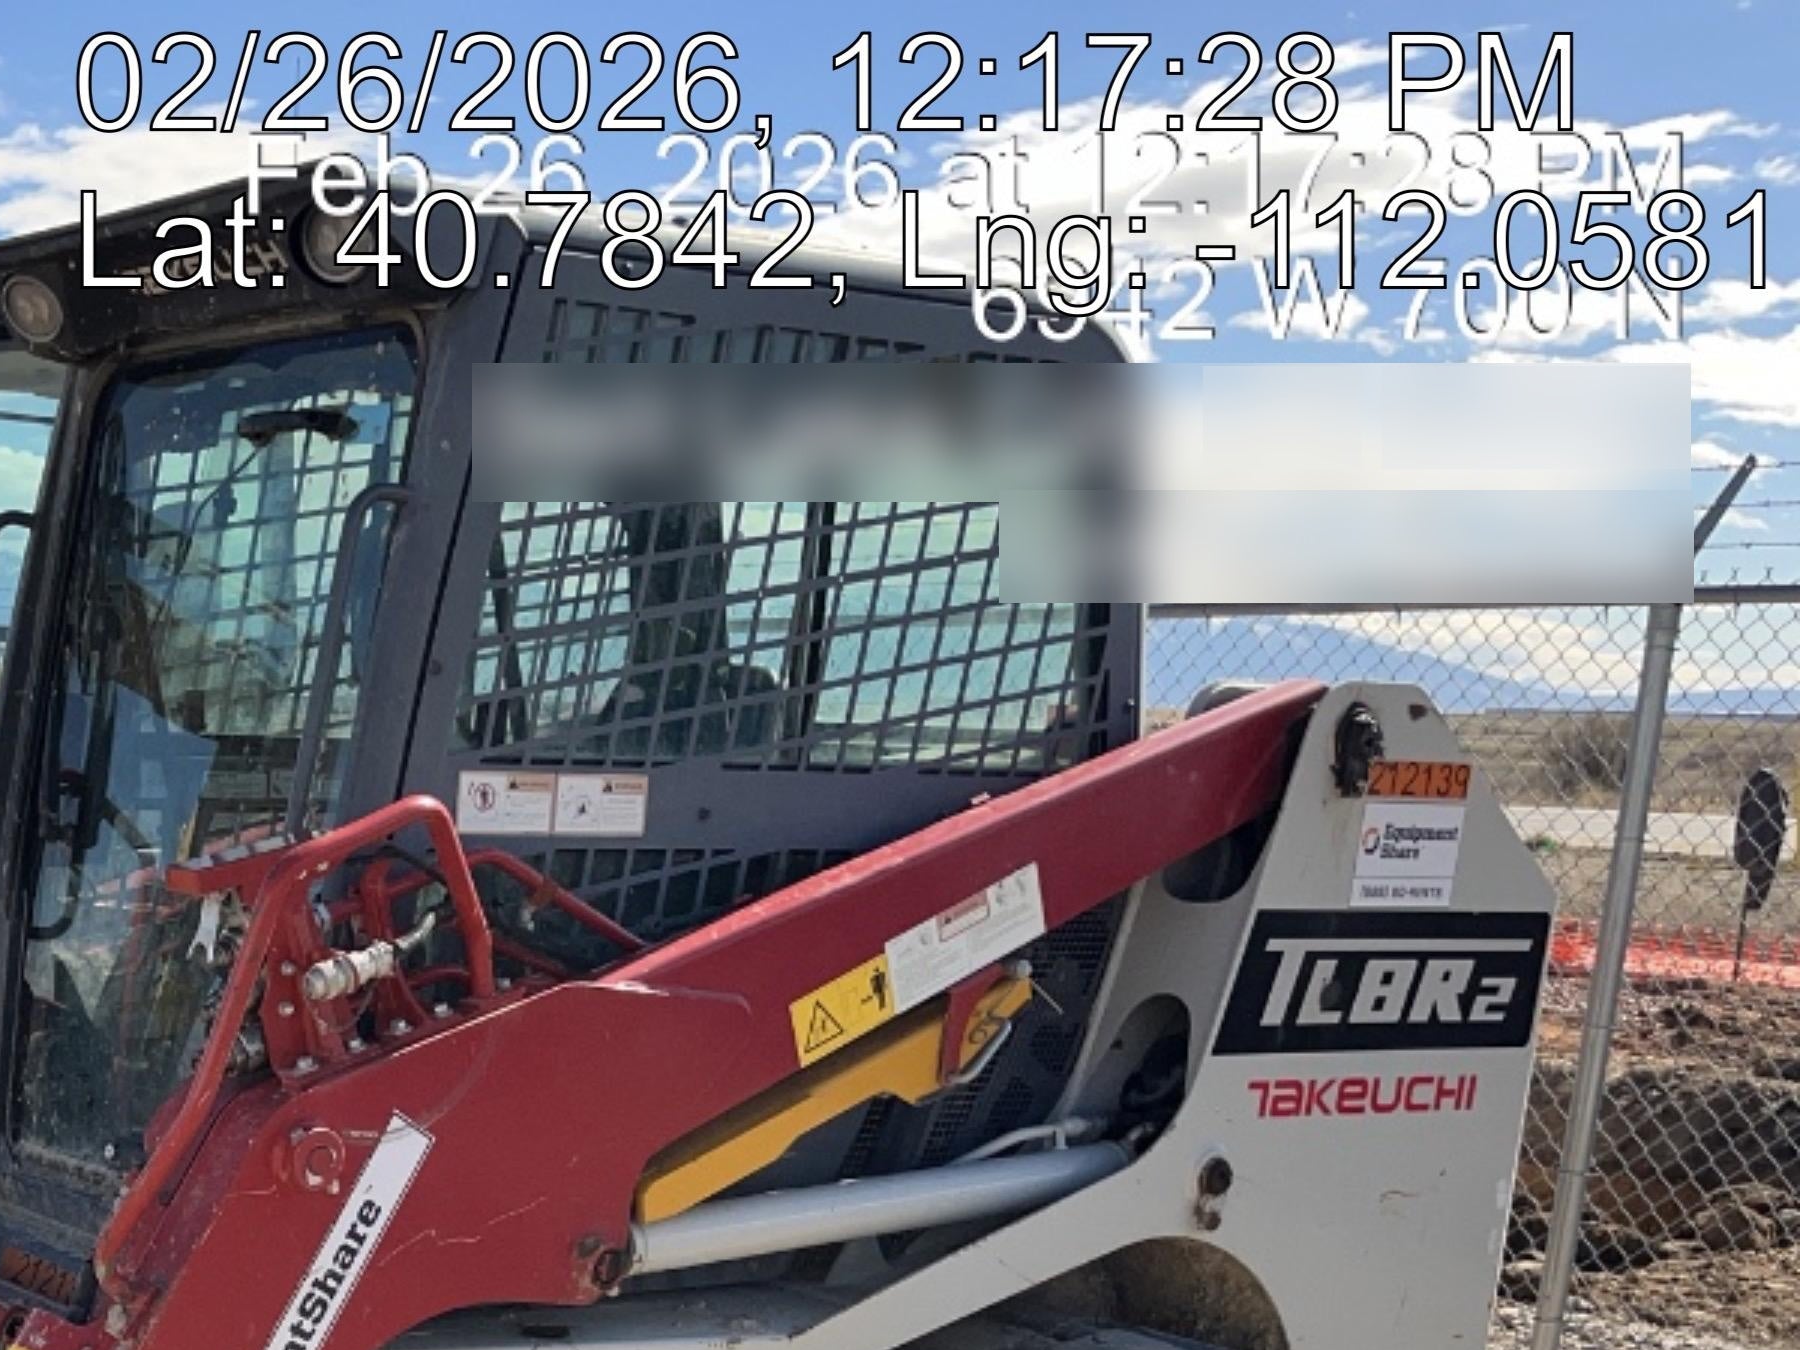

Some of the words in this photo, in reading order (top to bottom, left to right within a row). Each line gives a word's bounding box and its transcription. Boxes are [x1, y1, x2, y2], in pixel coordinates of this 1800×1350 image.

[1367, 760, 1472, 799] 212139
[1382, 822, 1460, 844] Equipment
[1247, 1074, 1478, 1118] TAKEUCHI
